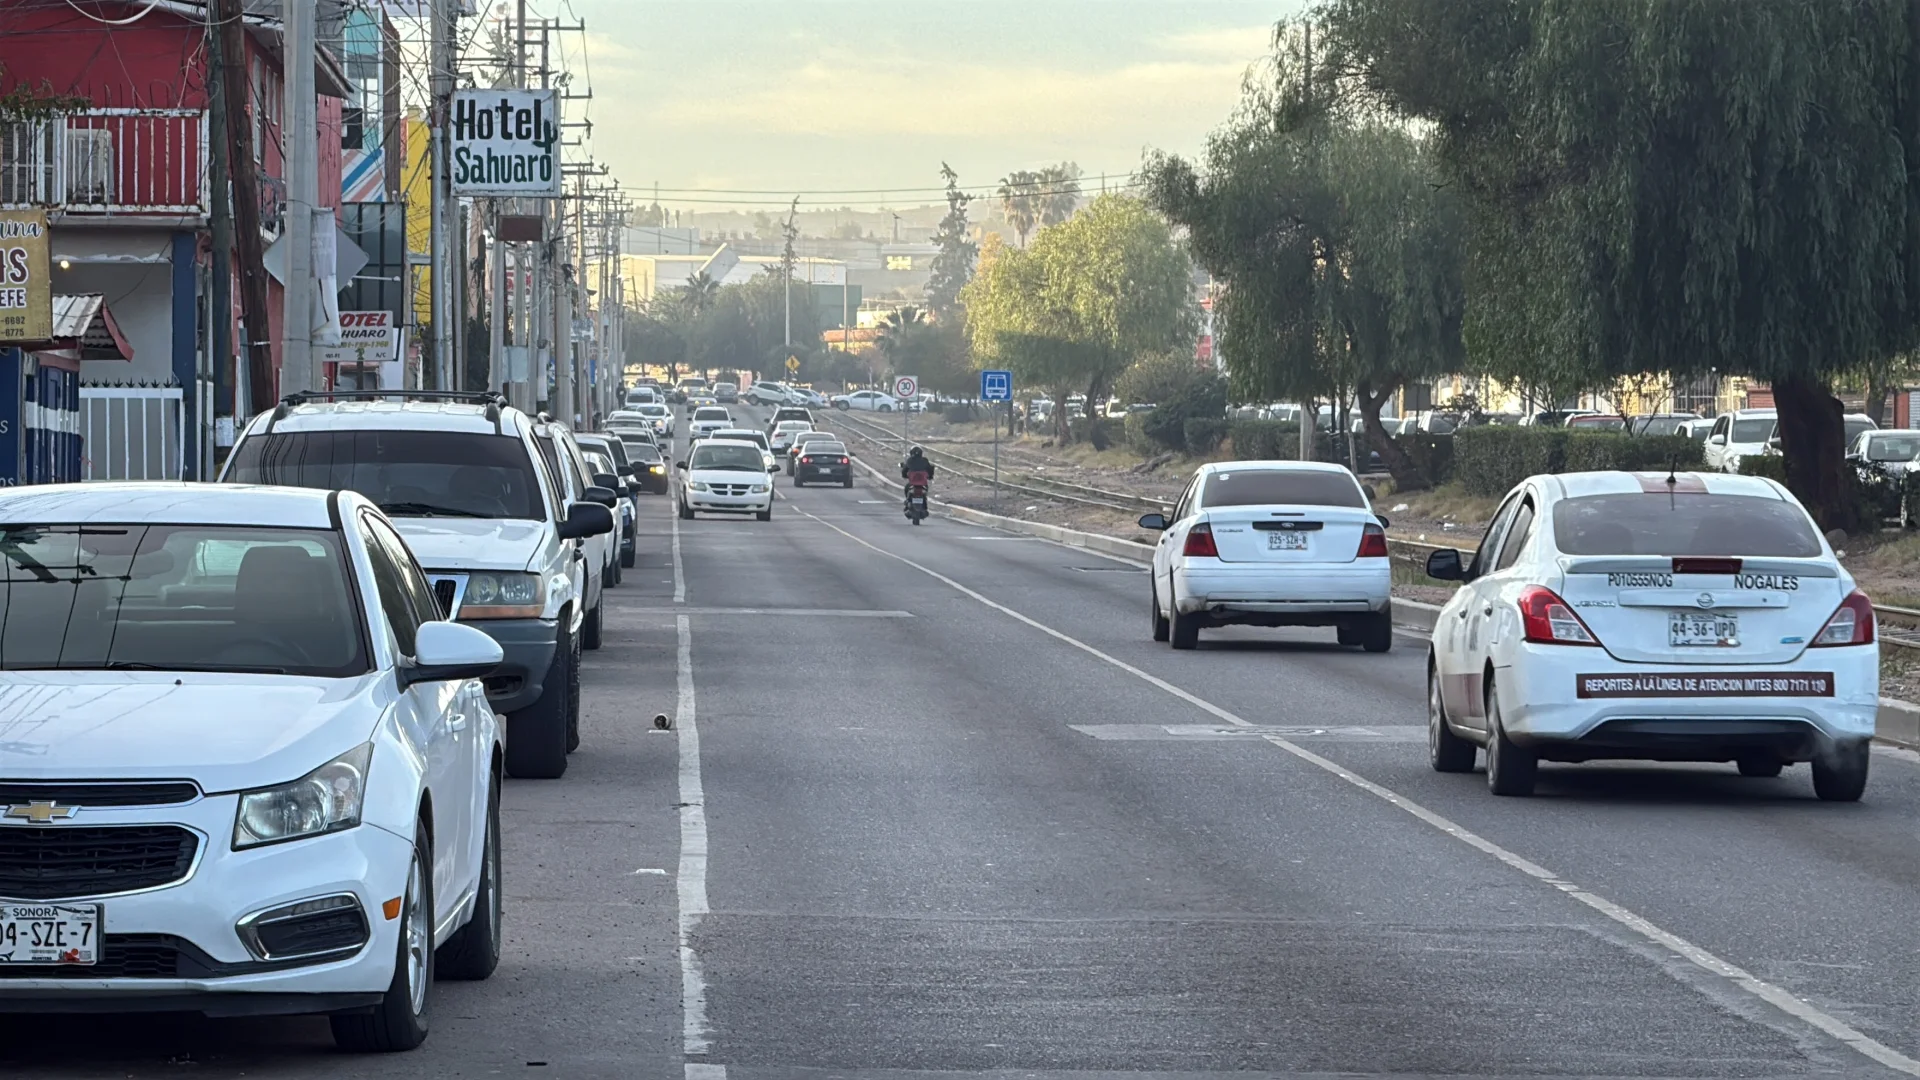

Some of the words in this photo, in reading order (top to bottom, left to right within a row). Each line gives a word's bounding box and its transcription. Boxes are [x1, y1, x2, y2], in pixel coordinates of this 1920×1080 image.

[456, 99, 541, 140] Hotel
[455, 146, 551, 184] Sahuaro
[340, 313, 387, 327] OTEL
[341, 329, 387, 338] HUARO
[1608, 573, 1673, 587] P010555NOG
[1734, 575, 1799, 590] NOGALES
[1672, 622, 1736, 637] 44-36-UPD
[1585, 679, 1633, 691] REPORTES
[1635, 679, 1642, 690] A
[1643, 679, 1655, 690] LA
[1685, 679, 1698, 690] DE
[13, 907, 59, 917] SONORA
